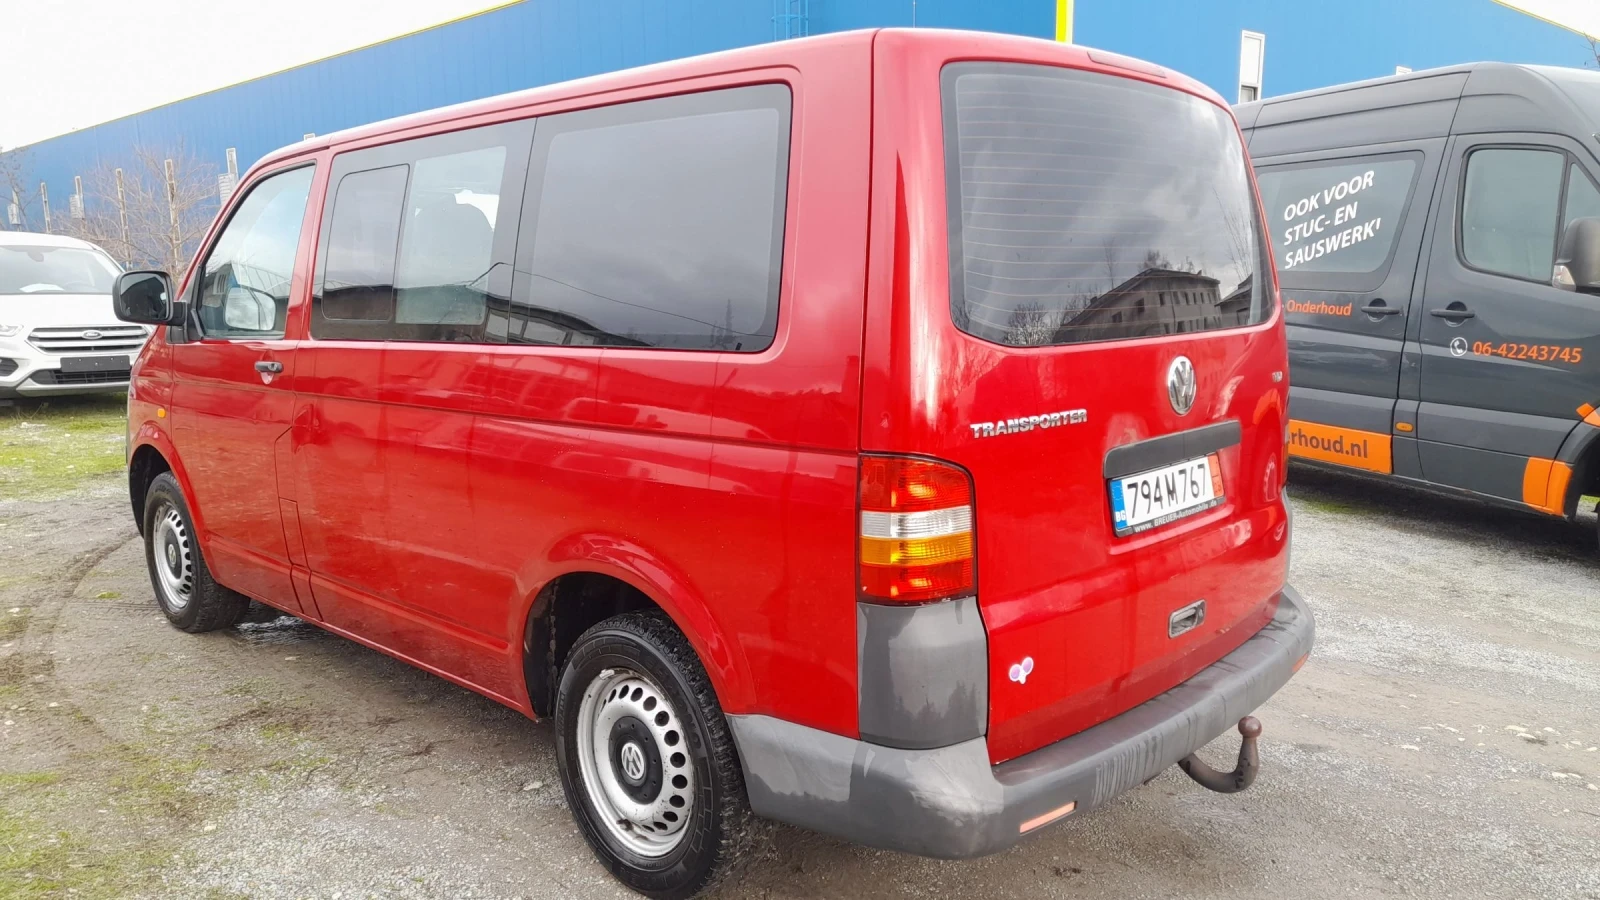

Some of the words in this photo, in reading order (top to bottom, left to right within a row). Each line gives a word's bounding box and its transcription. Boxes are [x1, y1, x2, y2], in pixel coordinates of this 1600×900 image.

[1284, 192, 1321, 221] OOK
[1323, 170, 1375, 205] VOOR
[1284, 214, 1331, 246] STUC-
[1334, 201, 1358, 226] EN
[1286, 299, 1353, 316] Onderhoud
[1472, 341, 1583, 363] 06-42243745
[969, 408, 1088, 439] TRANSPORTER
[1287, 428, 1369, 459] rhoud.nl
[1115, 510, 1127, 523] BG
[1134, 522, 1153, 532] www.
